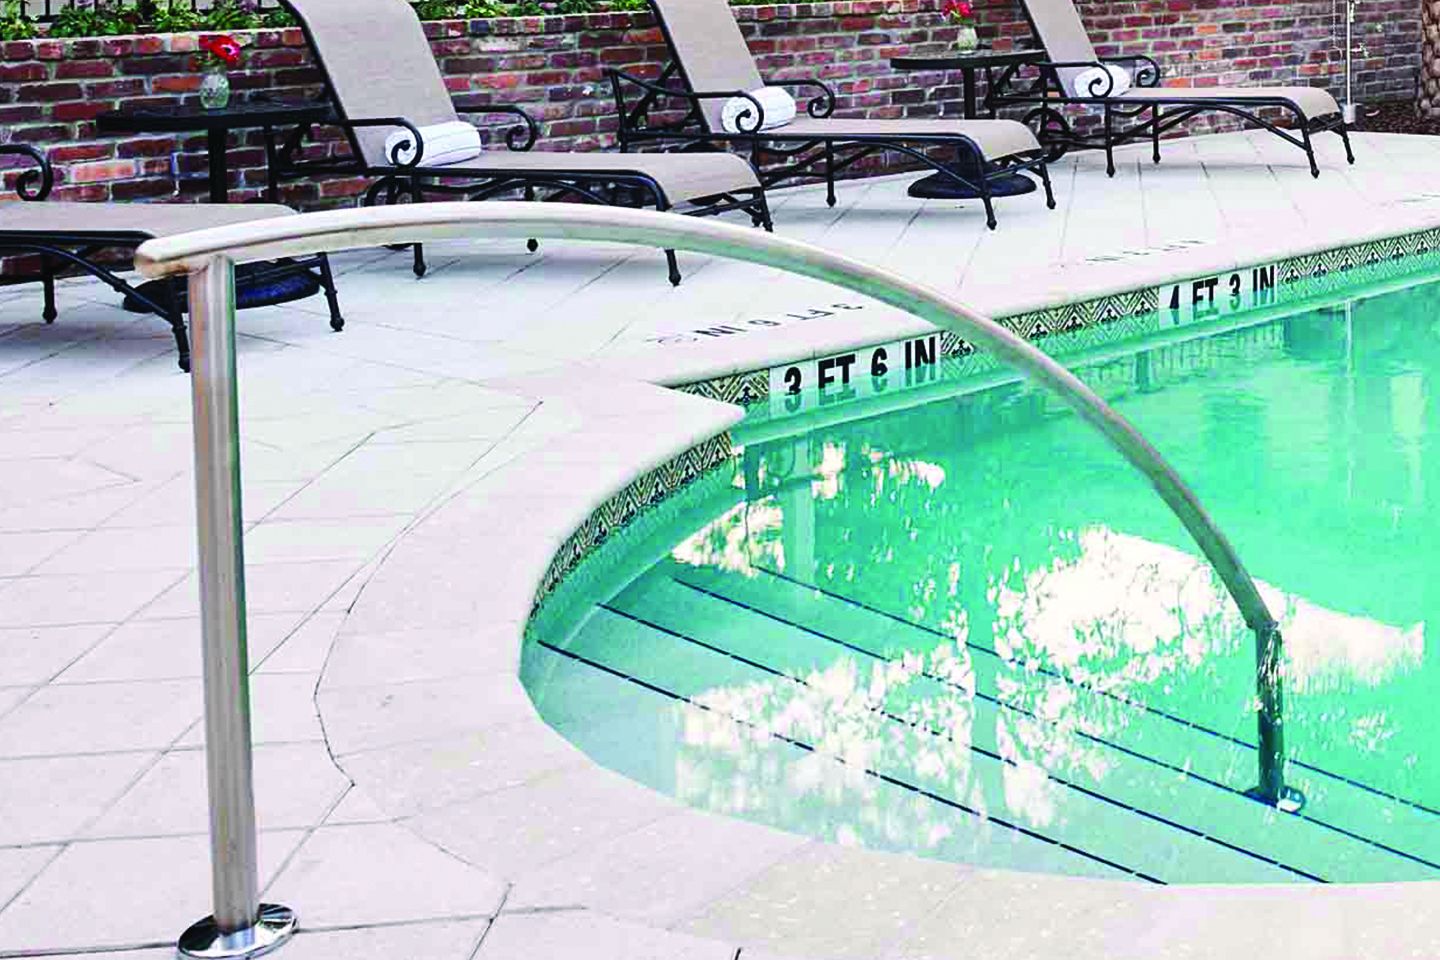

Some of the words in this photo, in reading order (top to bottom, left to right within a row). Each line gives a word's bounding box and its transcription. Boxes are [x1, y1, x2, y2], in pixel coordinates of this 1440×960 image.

[1192, 277, 1219, 305] FT
[1229, 273, 1241, 297] 3
[1253, 265, 1275, 292] IN
[786, 307, 835, 321] FT
[693, 324, 748, 338] IN
[784, 366, 802, 396] 3
[817, 353, 856, 389] FT
[871, 347, 888, 377] 6
[904, 336, 936, 370] IN
